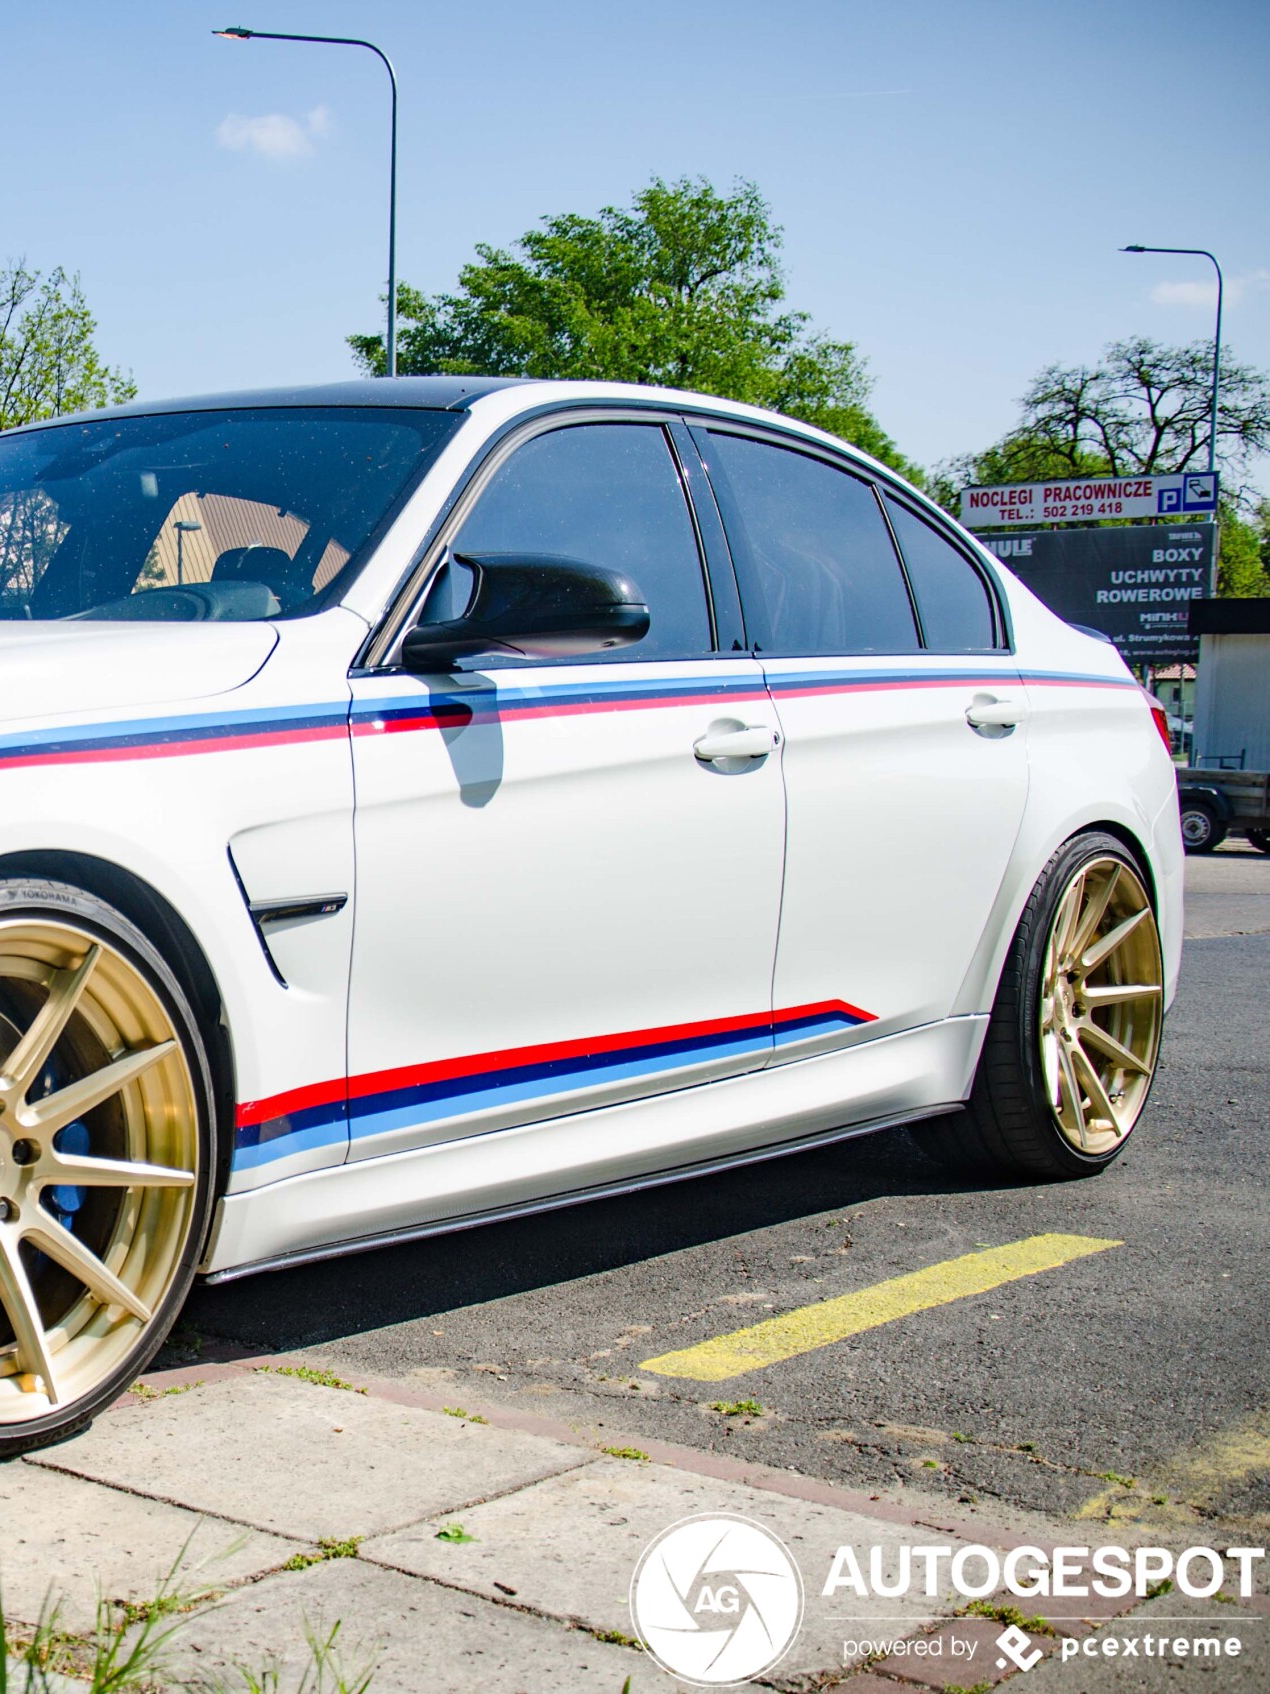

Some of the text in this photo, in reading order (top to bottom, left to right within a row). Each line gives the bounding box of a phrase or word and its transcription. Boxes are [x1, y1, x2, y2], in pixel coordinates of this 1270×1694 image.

[969, 481, 1152, 508] NOCLEGI PRACOWNICZE
[1043, 506, 1066, 518] 502
[1071, 504, 1094, 517] 219
[1098, 502, 1122, 515] 418
[983, 539, 1033, 557] HULE
[1152, 548, 1204, 563] BOXY
[1111, 568, 1204, 584] UCHWYTY
[1096, 587, 1203, 603] ROWEROWE
[1128, 633, 1190, 643] Strumykowa
[21, 889, 77, 905] YOKOHAMA
